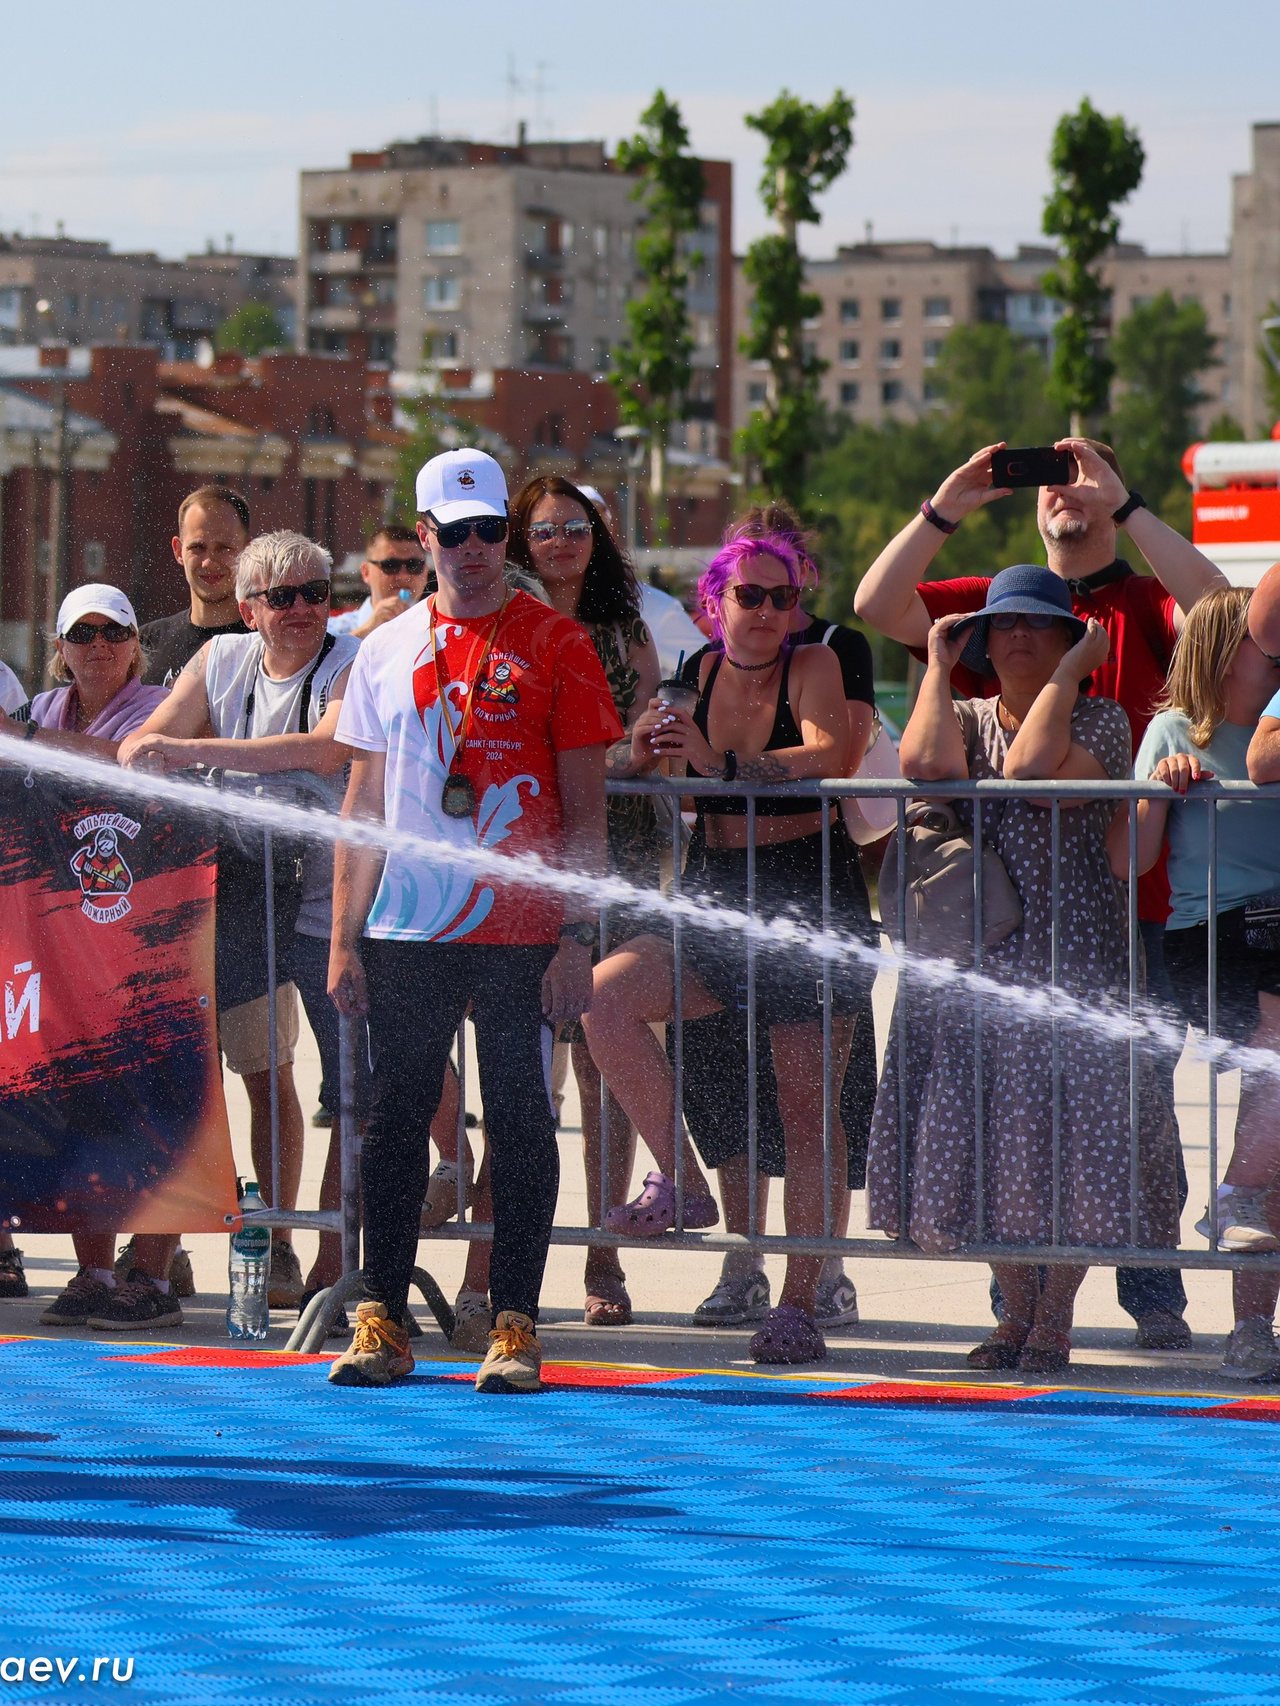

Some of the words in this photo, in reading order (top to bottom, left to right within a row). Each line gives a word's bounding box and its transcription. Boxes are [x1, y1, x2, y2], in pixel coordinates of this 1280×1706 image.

[478, 651, 531, 670] ИЛЬНЕЙШИЙ
[474, 706, 517, 722] ПОЖАРНЫЙ
[486, 751, 503, 761] 2024
[75, 815, 139, 839] СИЛЬНЕЙШИЙ
[82, 899, 131, 922] ПОЖАРНЫЙ
